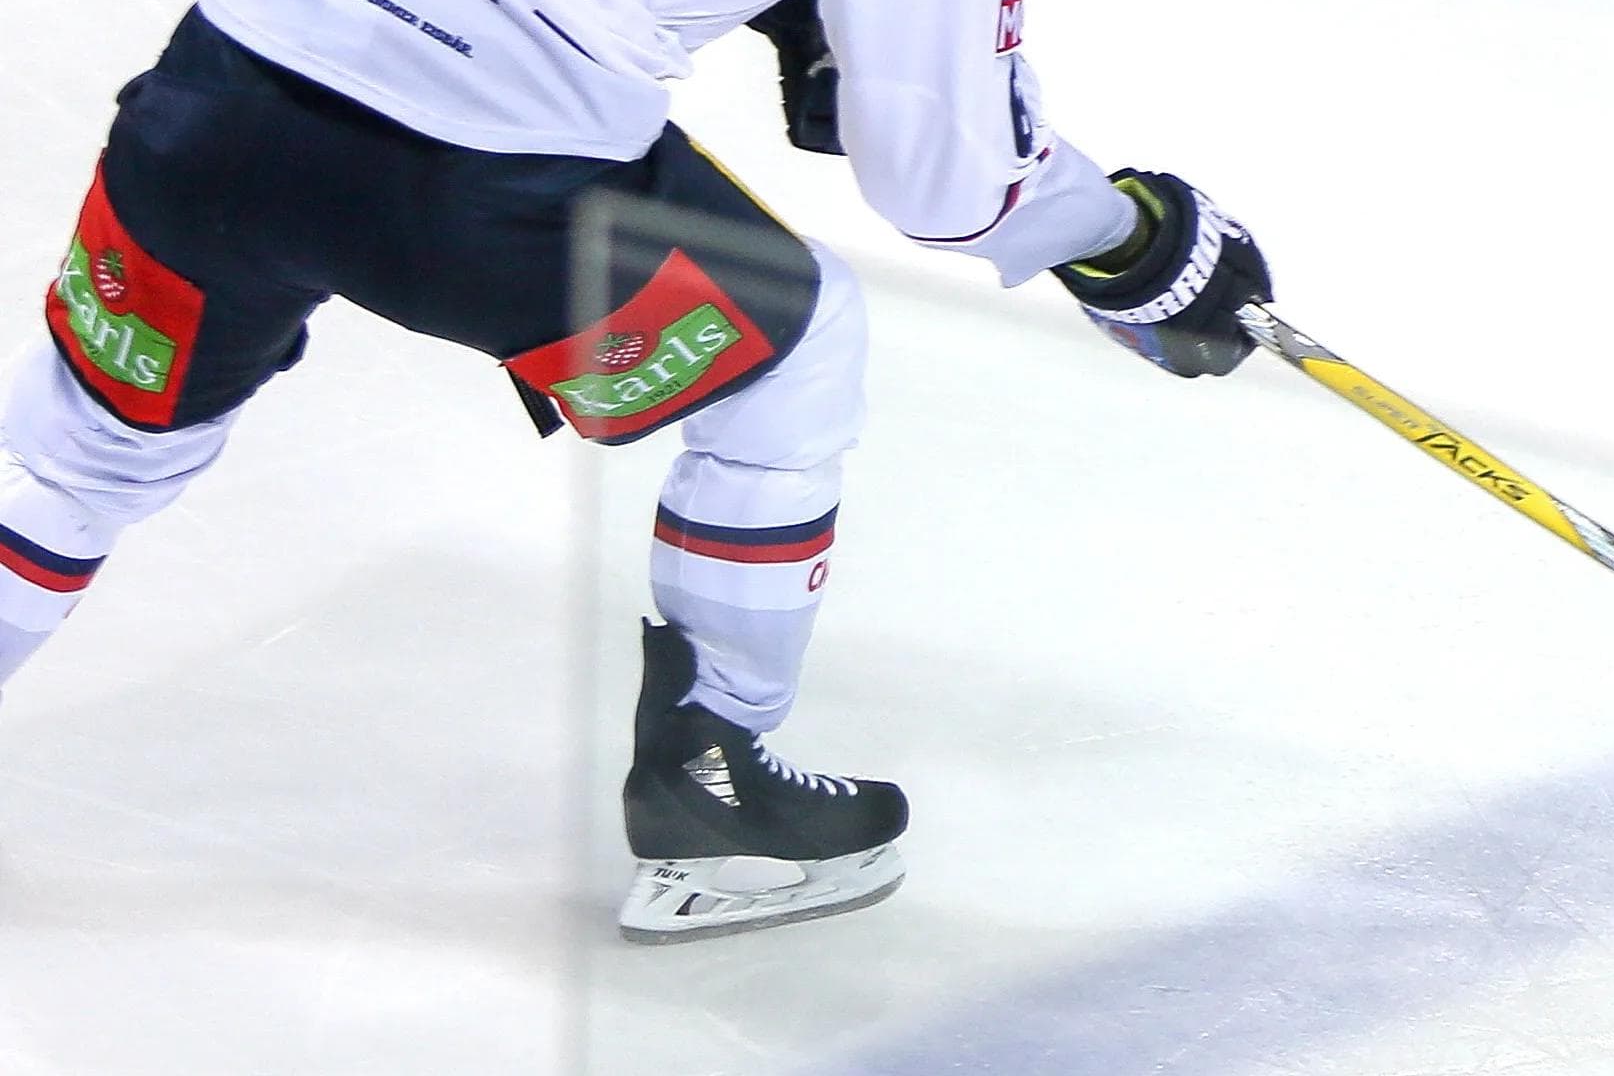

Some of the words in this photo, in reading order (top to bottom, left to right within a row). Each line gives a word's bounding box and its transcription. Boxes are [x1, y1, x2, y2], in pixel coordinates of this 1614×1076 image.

[56, 251, 161, 386] Karls
[564, 321, 728, 415] Karls
[1411, 431, 1532, 502] TACKS
